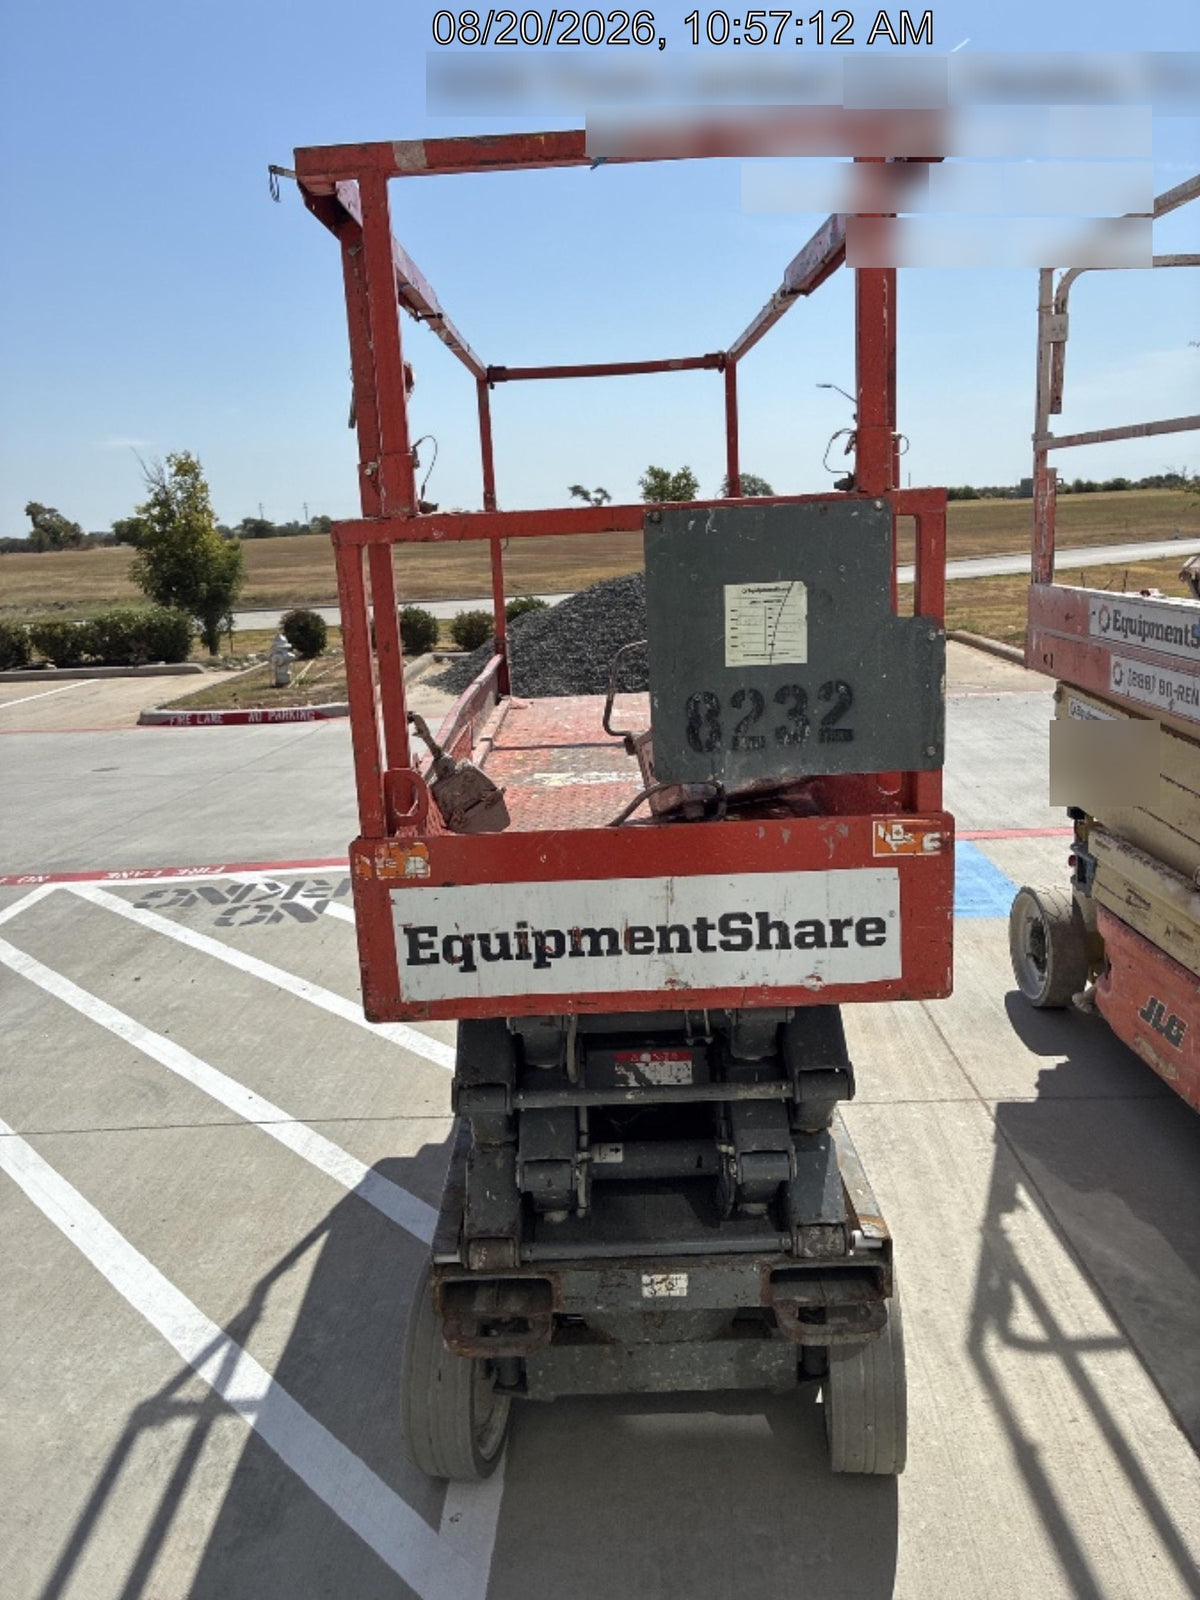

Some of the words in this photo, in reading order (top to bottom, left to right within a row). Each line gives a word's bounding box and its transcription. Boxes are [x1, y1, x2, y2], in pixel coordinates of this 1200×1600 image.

[268, 710, 316, 722] PARKING
[685, 679, 855, 753] 8232
[132, 878, 351, 908] RKING
[213, 899, 331, 927] NO
[403, 912, 887, 973] EquipmentShare
[1138, 995, 1188, 1052] JLG
